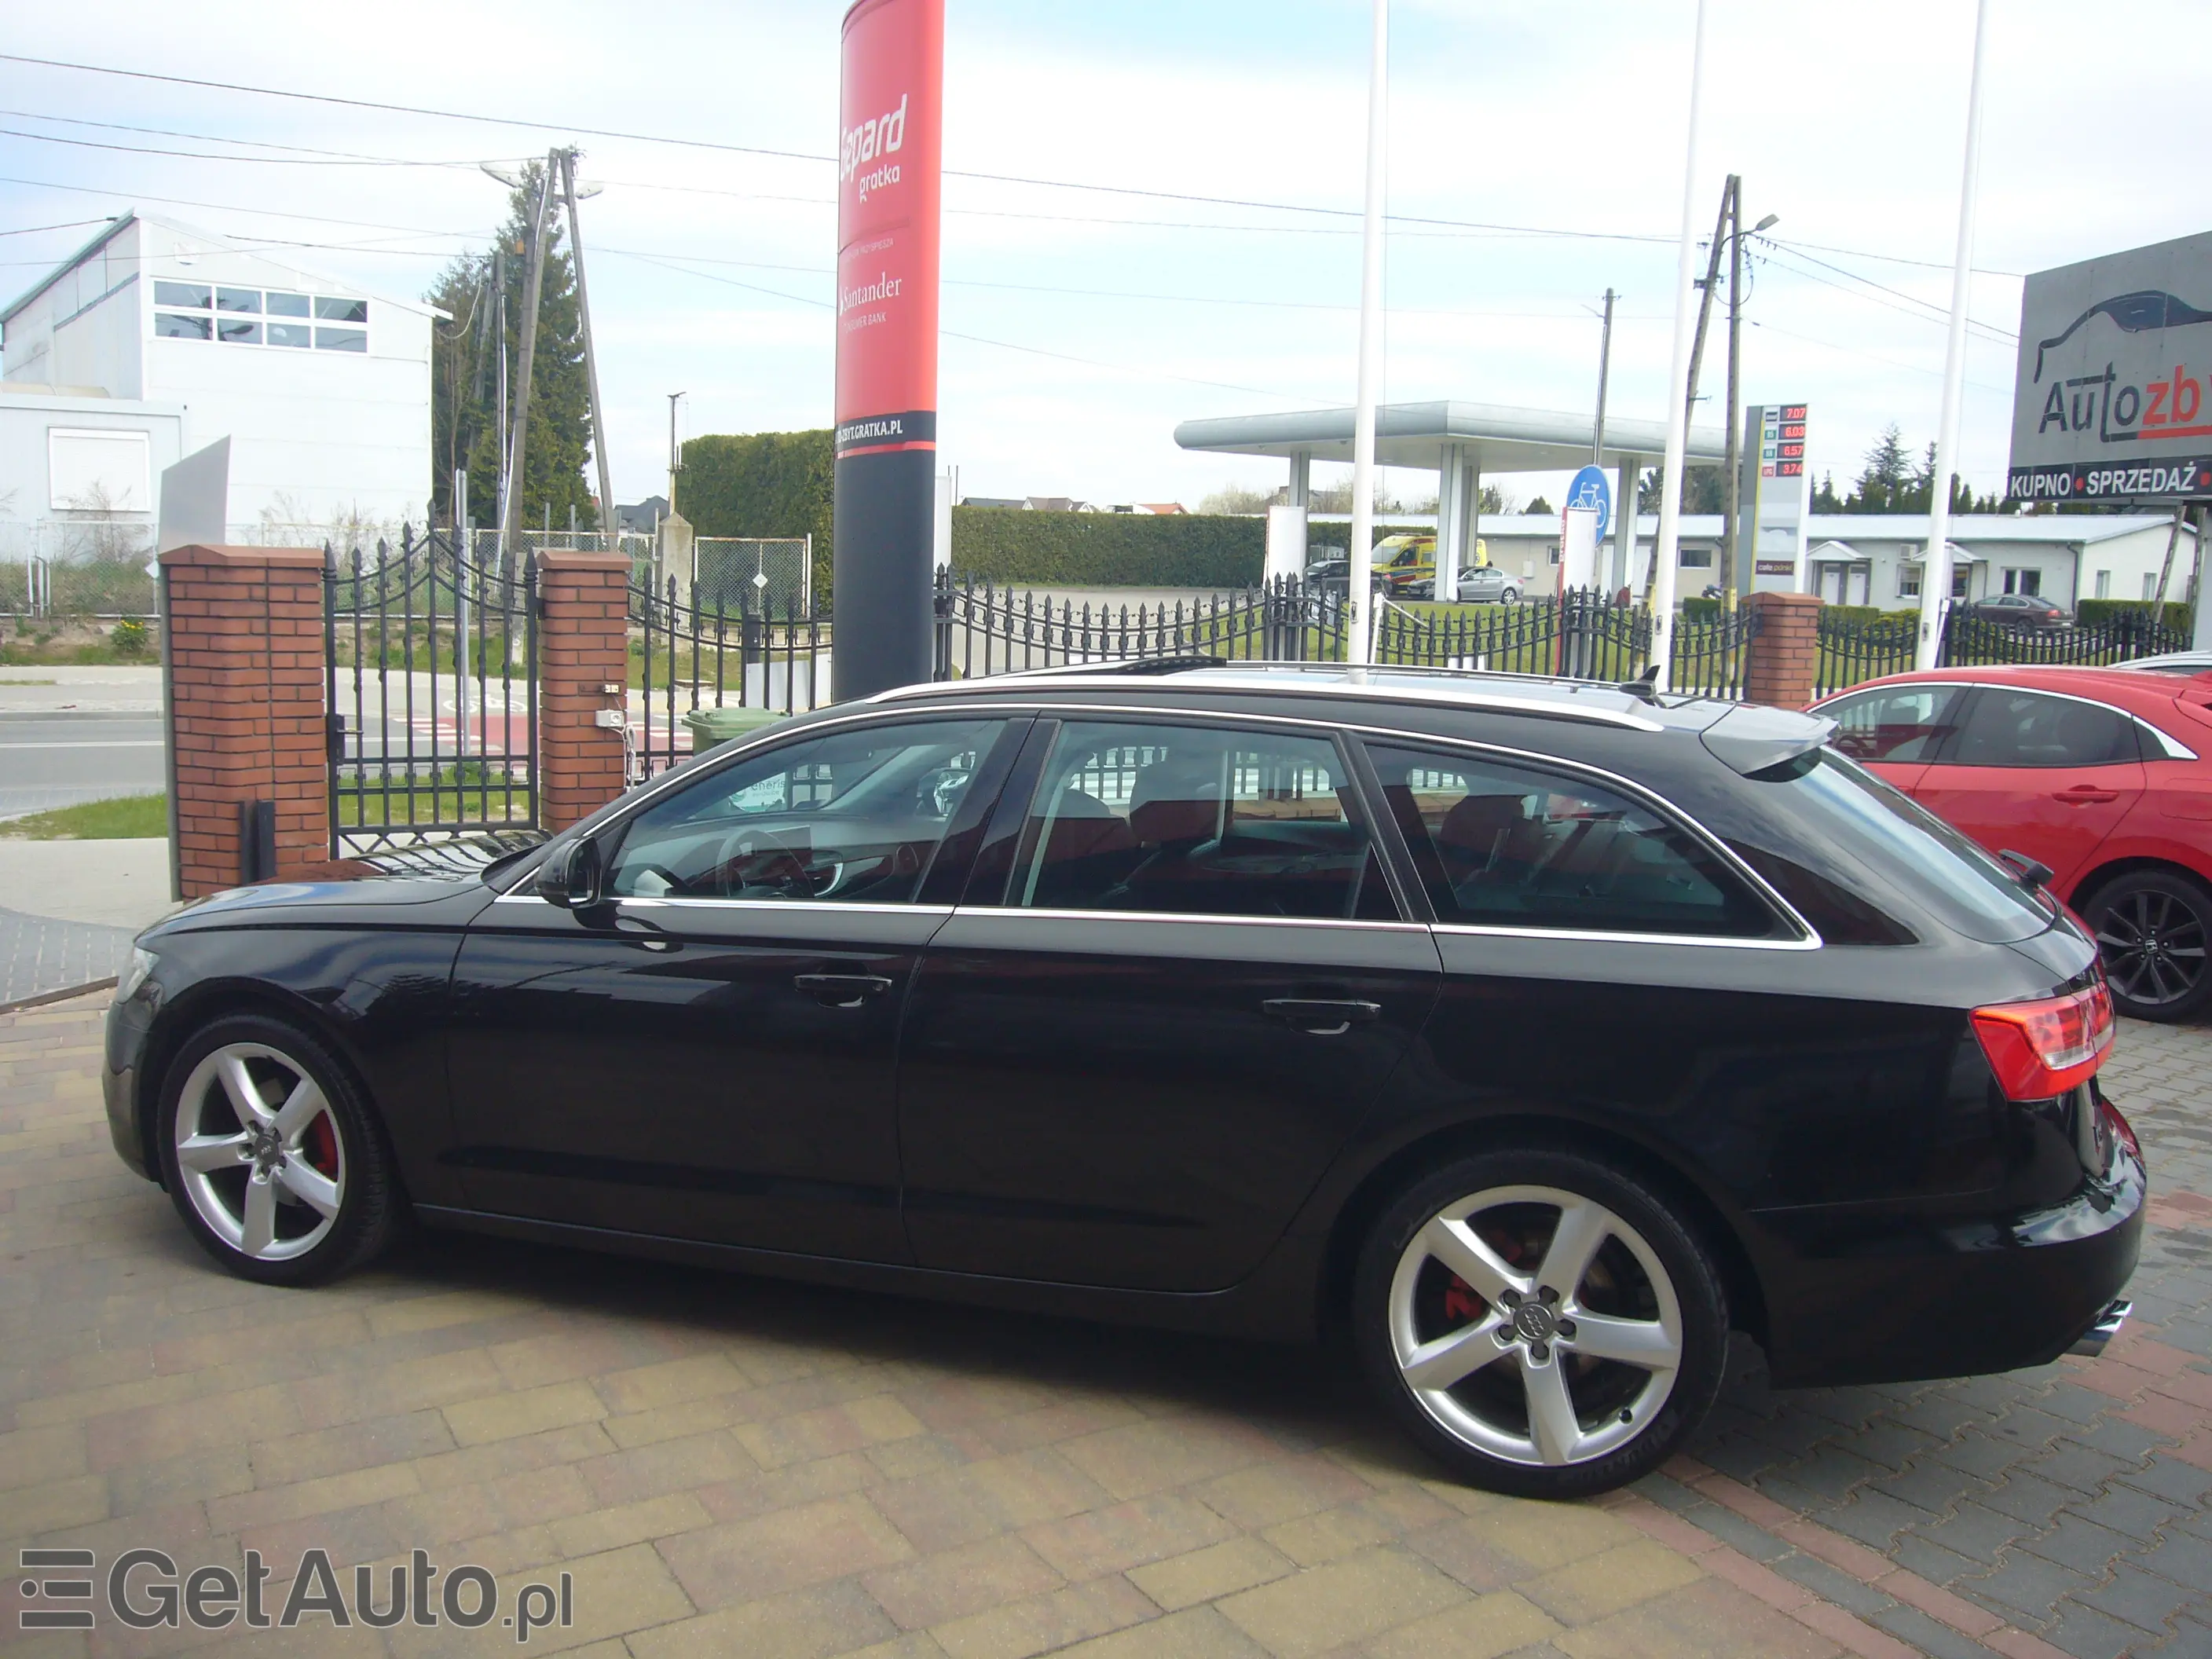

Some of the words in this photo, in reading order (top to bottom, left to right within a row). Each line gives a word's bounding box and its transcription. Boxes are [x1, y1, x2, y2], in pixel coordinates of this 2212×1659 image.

[859, 163, 900, 203] gratka
[844, 271, 902, 312] Santander
[867, 313, 886, 326] BANK
[2039, 360, 2212, 443] Autozb
[2010, 473, 2072, 498] KUPNO
[2086, 461, 2198, 496] SPRZEDAŻ
